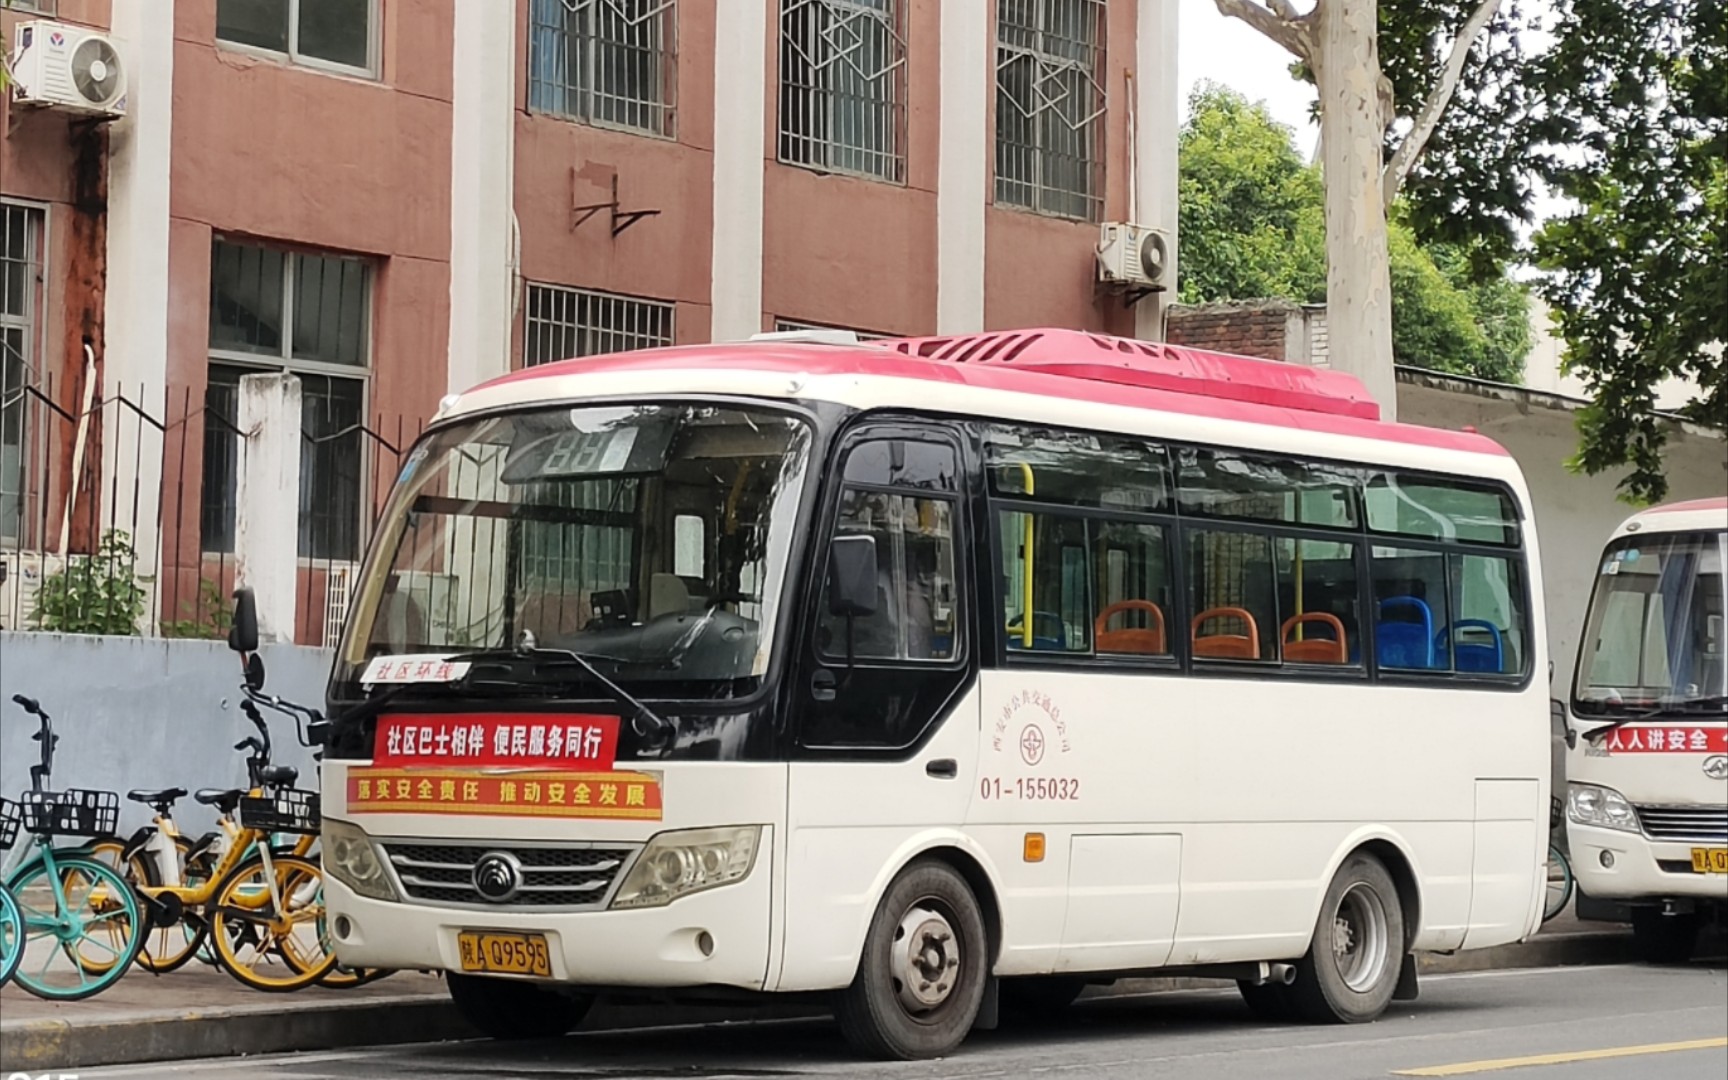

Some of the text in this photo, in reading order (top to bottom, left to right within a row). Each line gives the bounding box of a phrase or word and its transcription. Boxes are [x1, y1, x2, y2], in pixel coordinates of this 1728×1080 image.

[376, 661, 455, 681] 社区环线
[387, 725, 603, 759] 社区巴士相伴 便民服务同行
[1608, 728, 1709, 751] 人人讲安全
[357, 778, 646, 807] 落实安全责任 推动安全发展
[980, 776, 1080, 801] 01-155032
